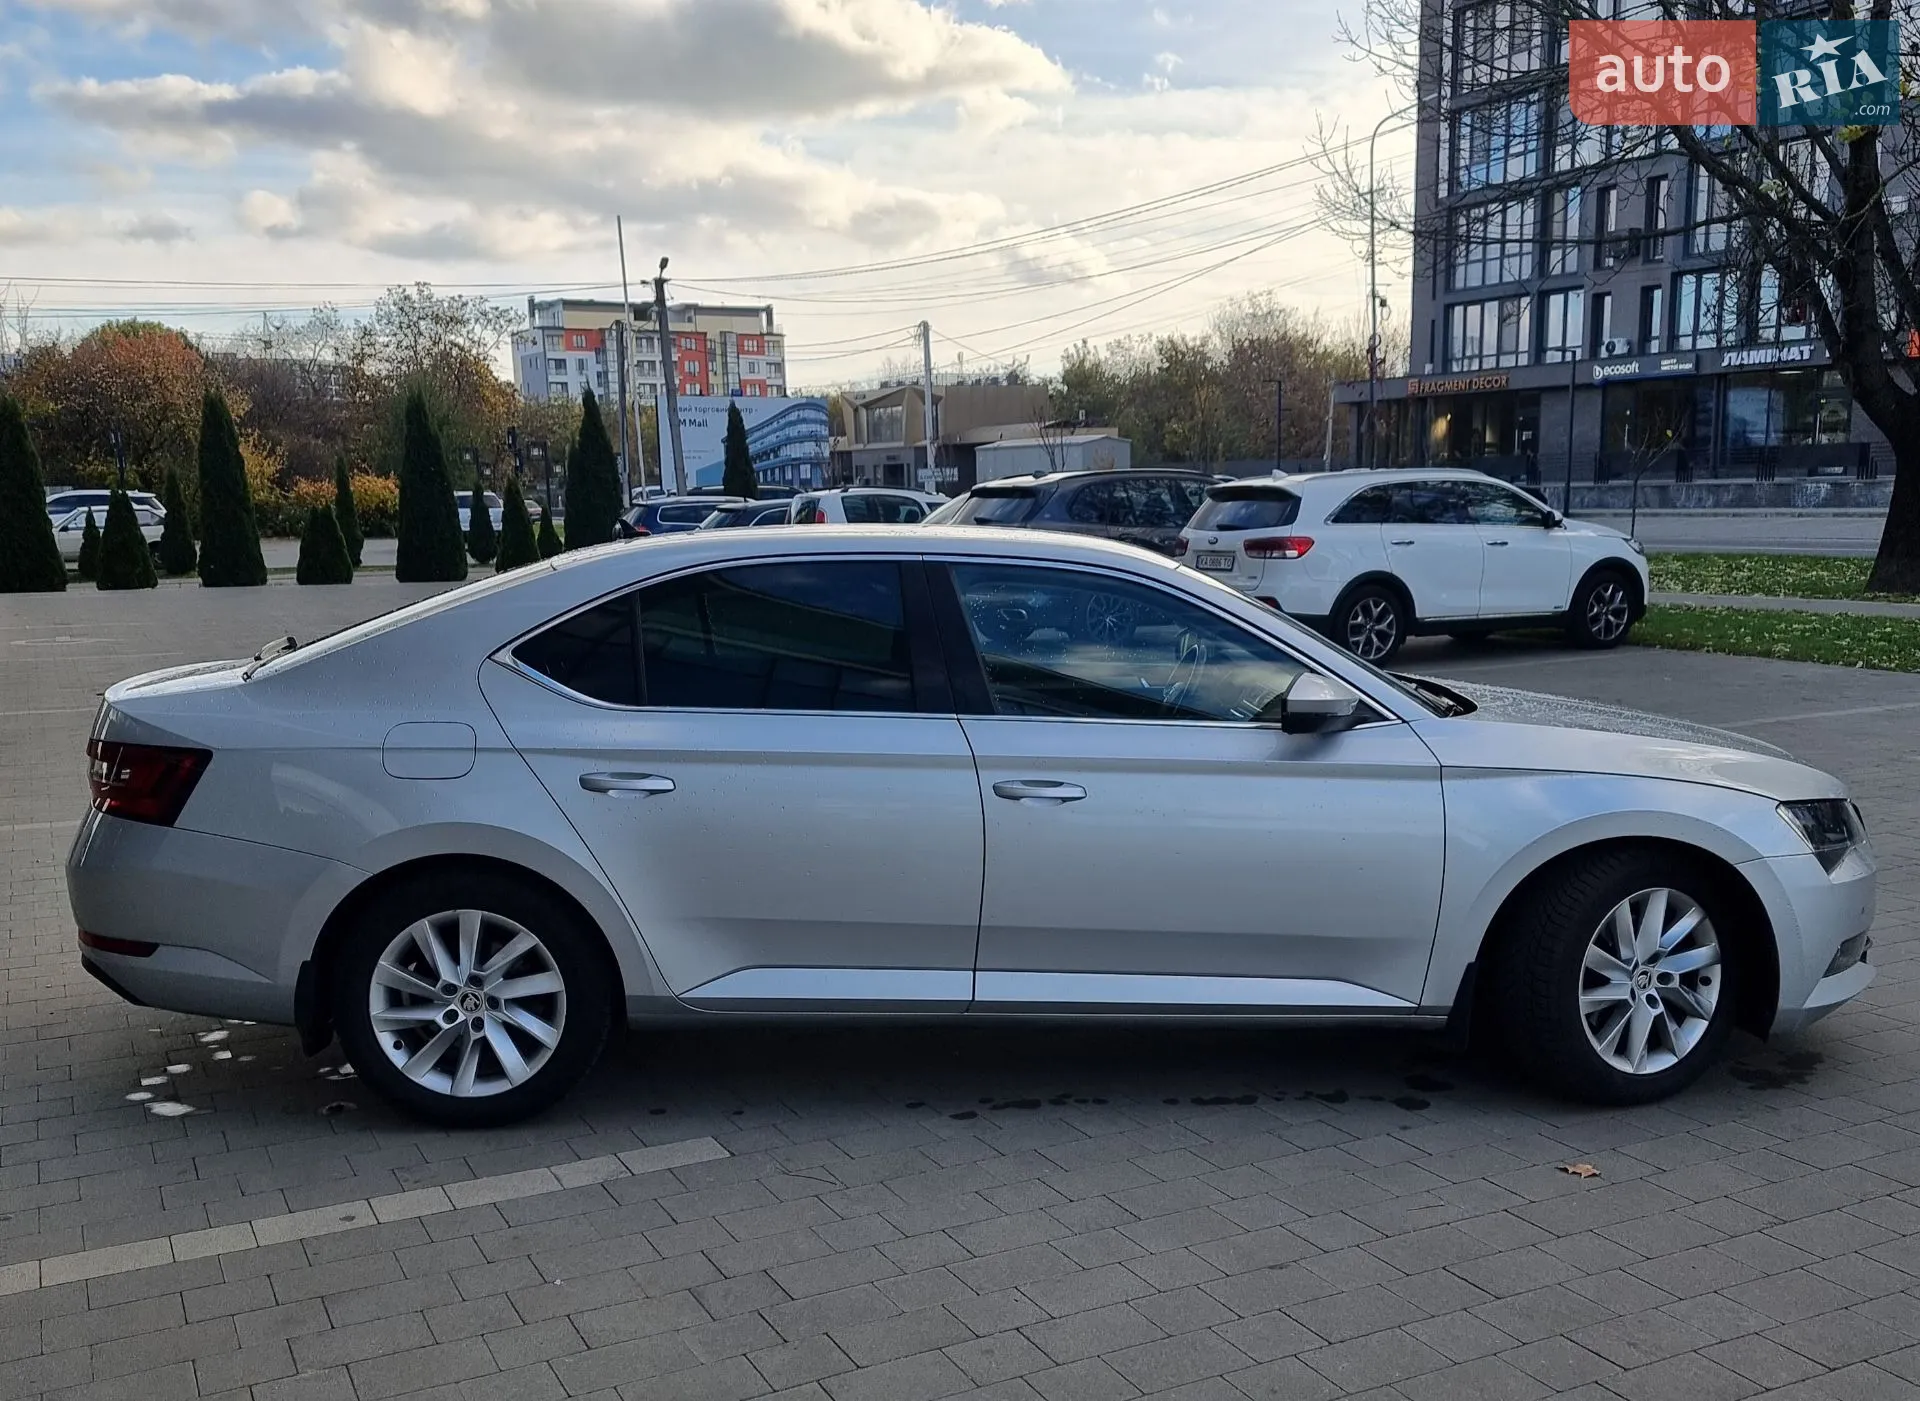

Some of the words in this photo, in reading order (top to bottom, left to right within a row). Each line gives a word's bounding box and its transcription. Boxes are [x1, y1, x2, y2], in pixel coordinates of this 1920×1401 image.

[1603, 360, 1640, 376] ecosoft
[1420, 379, 1470, 393] FRAGMENT
[1472, 375, 1508, 389] DECOR
[689, 418, 708, 428] Mall
